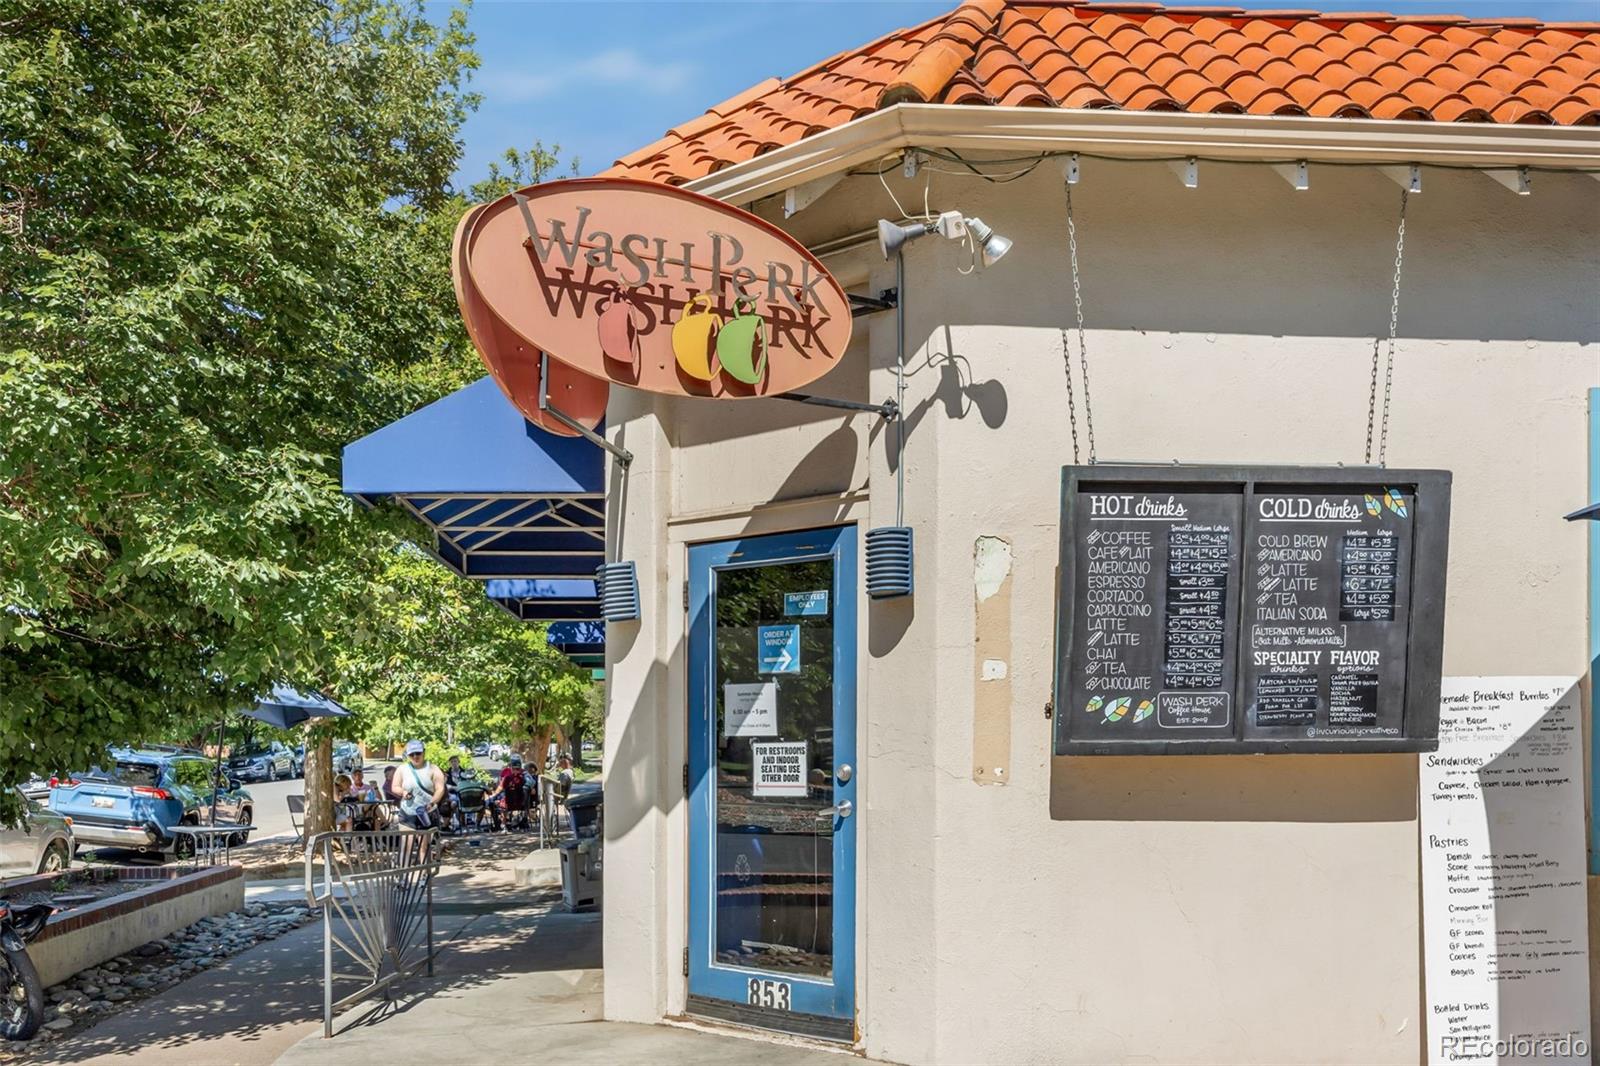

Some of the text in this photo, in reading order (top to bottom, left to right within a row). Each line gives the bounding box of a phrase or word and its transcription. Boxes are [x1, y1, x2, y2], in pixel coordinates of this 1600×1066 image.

[1090, 496, 1188, 517] HOT drinks
[1259, 498, 1363, 520] COLD drinks
[1101, 531, 1151, 545] COFFEE
[1258, 534, 1290, 548] COLD
[1293, 534, 1328, 548] BREW
[1087, 546, 1118, 560] CAFE
[1269, 549, 1322, 562] AMERICANO
[1087, 560, 1151, 575] AMERICANO
[1270, 563, 1308, 577] LATTE
[1087, 575, 1146, 589] ESPRESSO
[1282, 577, 1318, 591] LATTE
[789, 593, 825, 602] EMPLOYEES
[1086, 590, 1144, 603] CORTADO
[1273, 592, 1298, 606] TEA
[798, 600, 816, 609] ONLY
[1086, 603, 1151, 617] CAPPUCCINO
[1256, 607, 1296, 621] ITALIAN
[1300, 606, 1328, 621] SODA
[1087, 618, 1127, 631] LATTE
[1255, 626, 1306, 636] ALTERNATIVE
[763, 631, 785, 639] ORDER
[1103, 632, 1141, 646] LATTE
[765, 638, 794, 647] WINDOW
[1086, 647, 1117, 661] CHAI
[1253, 650, 1322, 666] SPECIALTY
[1330, 650, 1380, 666] FLAVOR
[1102, 662, 1127, 675] TEA
[1270, 664, 1308, 674] drinks
[1337, 665, 1375, 674] options
[1101, 676, 1151, 690] CHOCOLATE
[1162, 696, 1225, 707] WASH PERK
[1473, 690, 1514, 703] Breakfast
[755, 746, 806, 756] FOR RESTROOMS
[762, 756, 800, 765] AND INDOOR
[1426, 755, 1484, 768] Sandwiches
[761, 764, 801, 774] SEATING USE
[761, 773, 800, 783] OTHER DOOR
[1429, 834, 1469, 849] Pastries
[1446, 852, 1472, 862] Danish
[1447, 862, 1469, 872] Scone
[1449, 929, 1462, 938] GF
[1448, 942, 1461, 951] GF
[1448, 952, 1477, 962] Cookies
[749, 978, 790, 1010] 853
[1463, 1002, 1491, 1012] Drinks
[1447, 1015, 1469, 1025] Water
